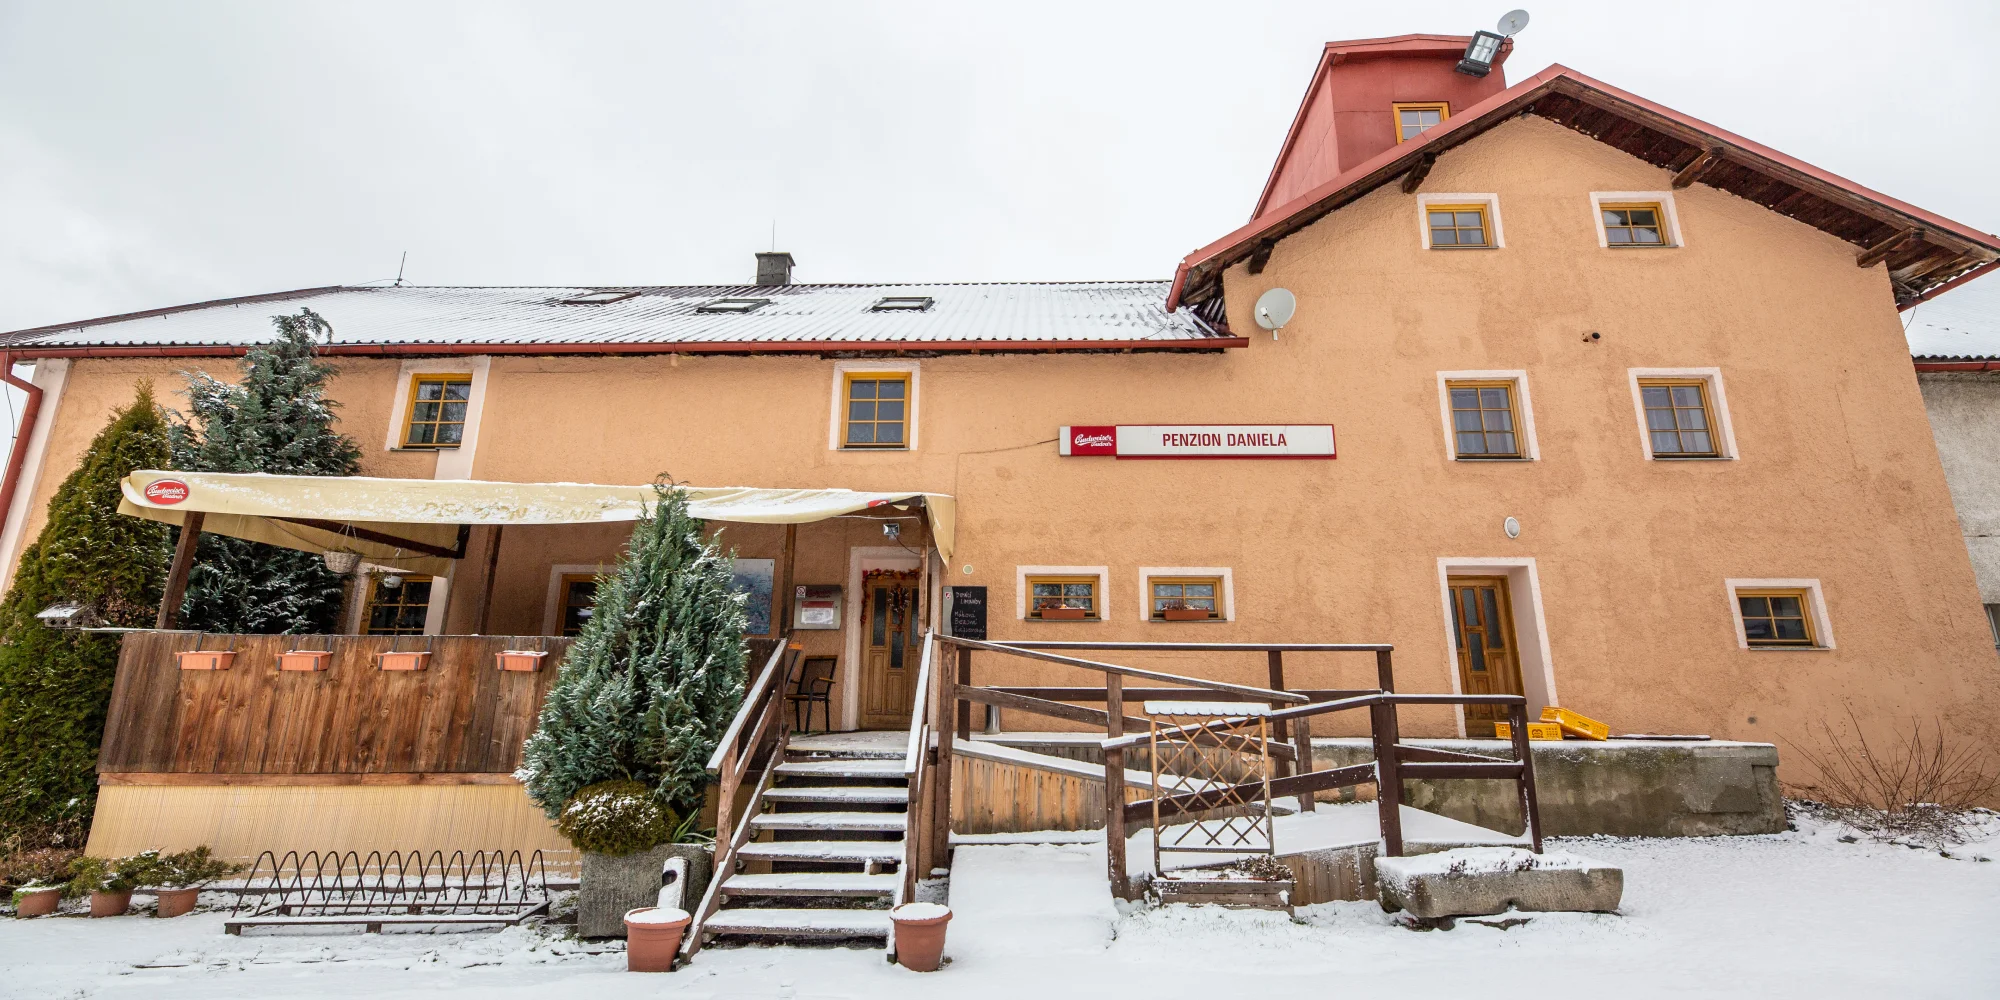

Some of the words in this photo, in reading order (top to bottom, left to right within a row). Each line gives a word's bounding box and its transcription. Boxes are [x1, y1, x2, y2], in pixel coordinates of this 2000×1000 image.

[1074, 433, 1113, 446] Budweiser
[1163, 433, 1221, 447] PENZION
[1227, 433, 1287, 447] DANIELA
